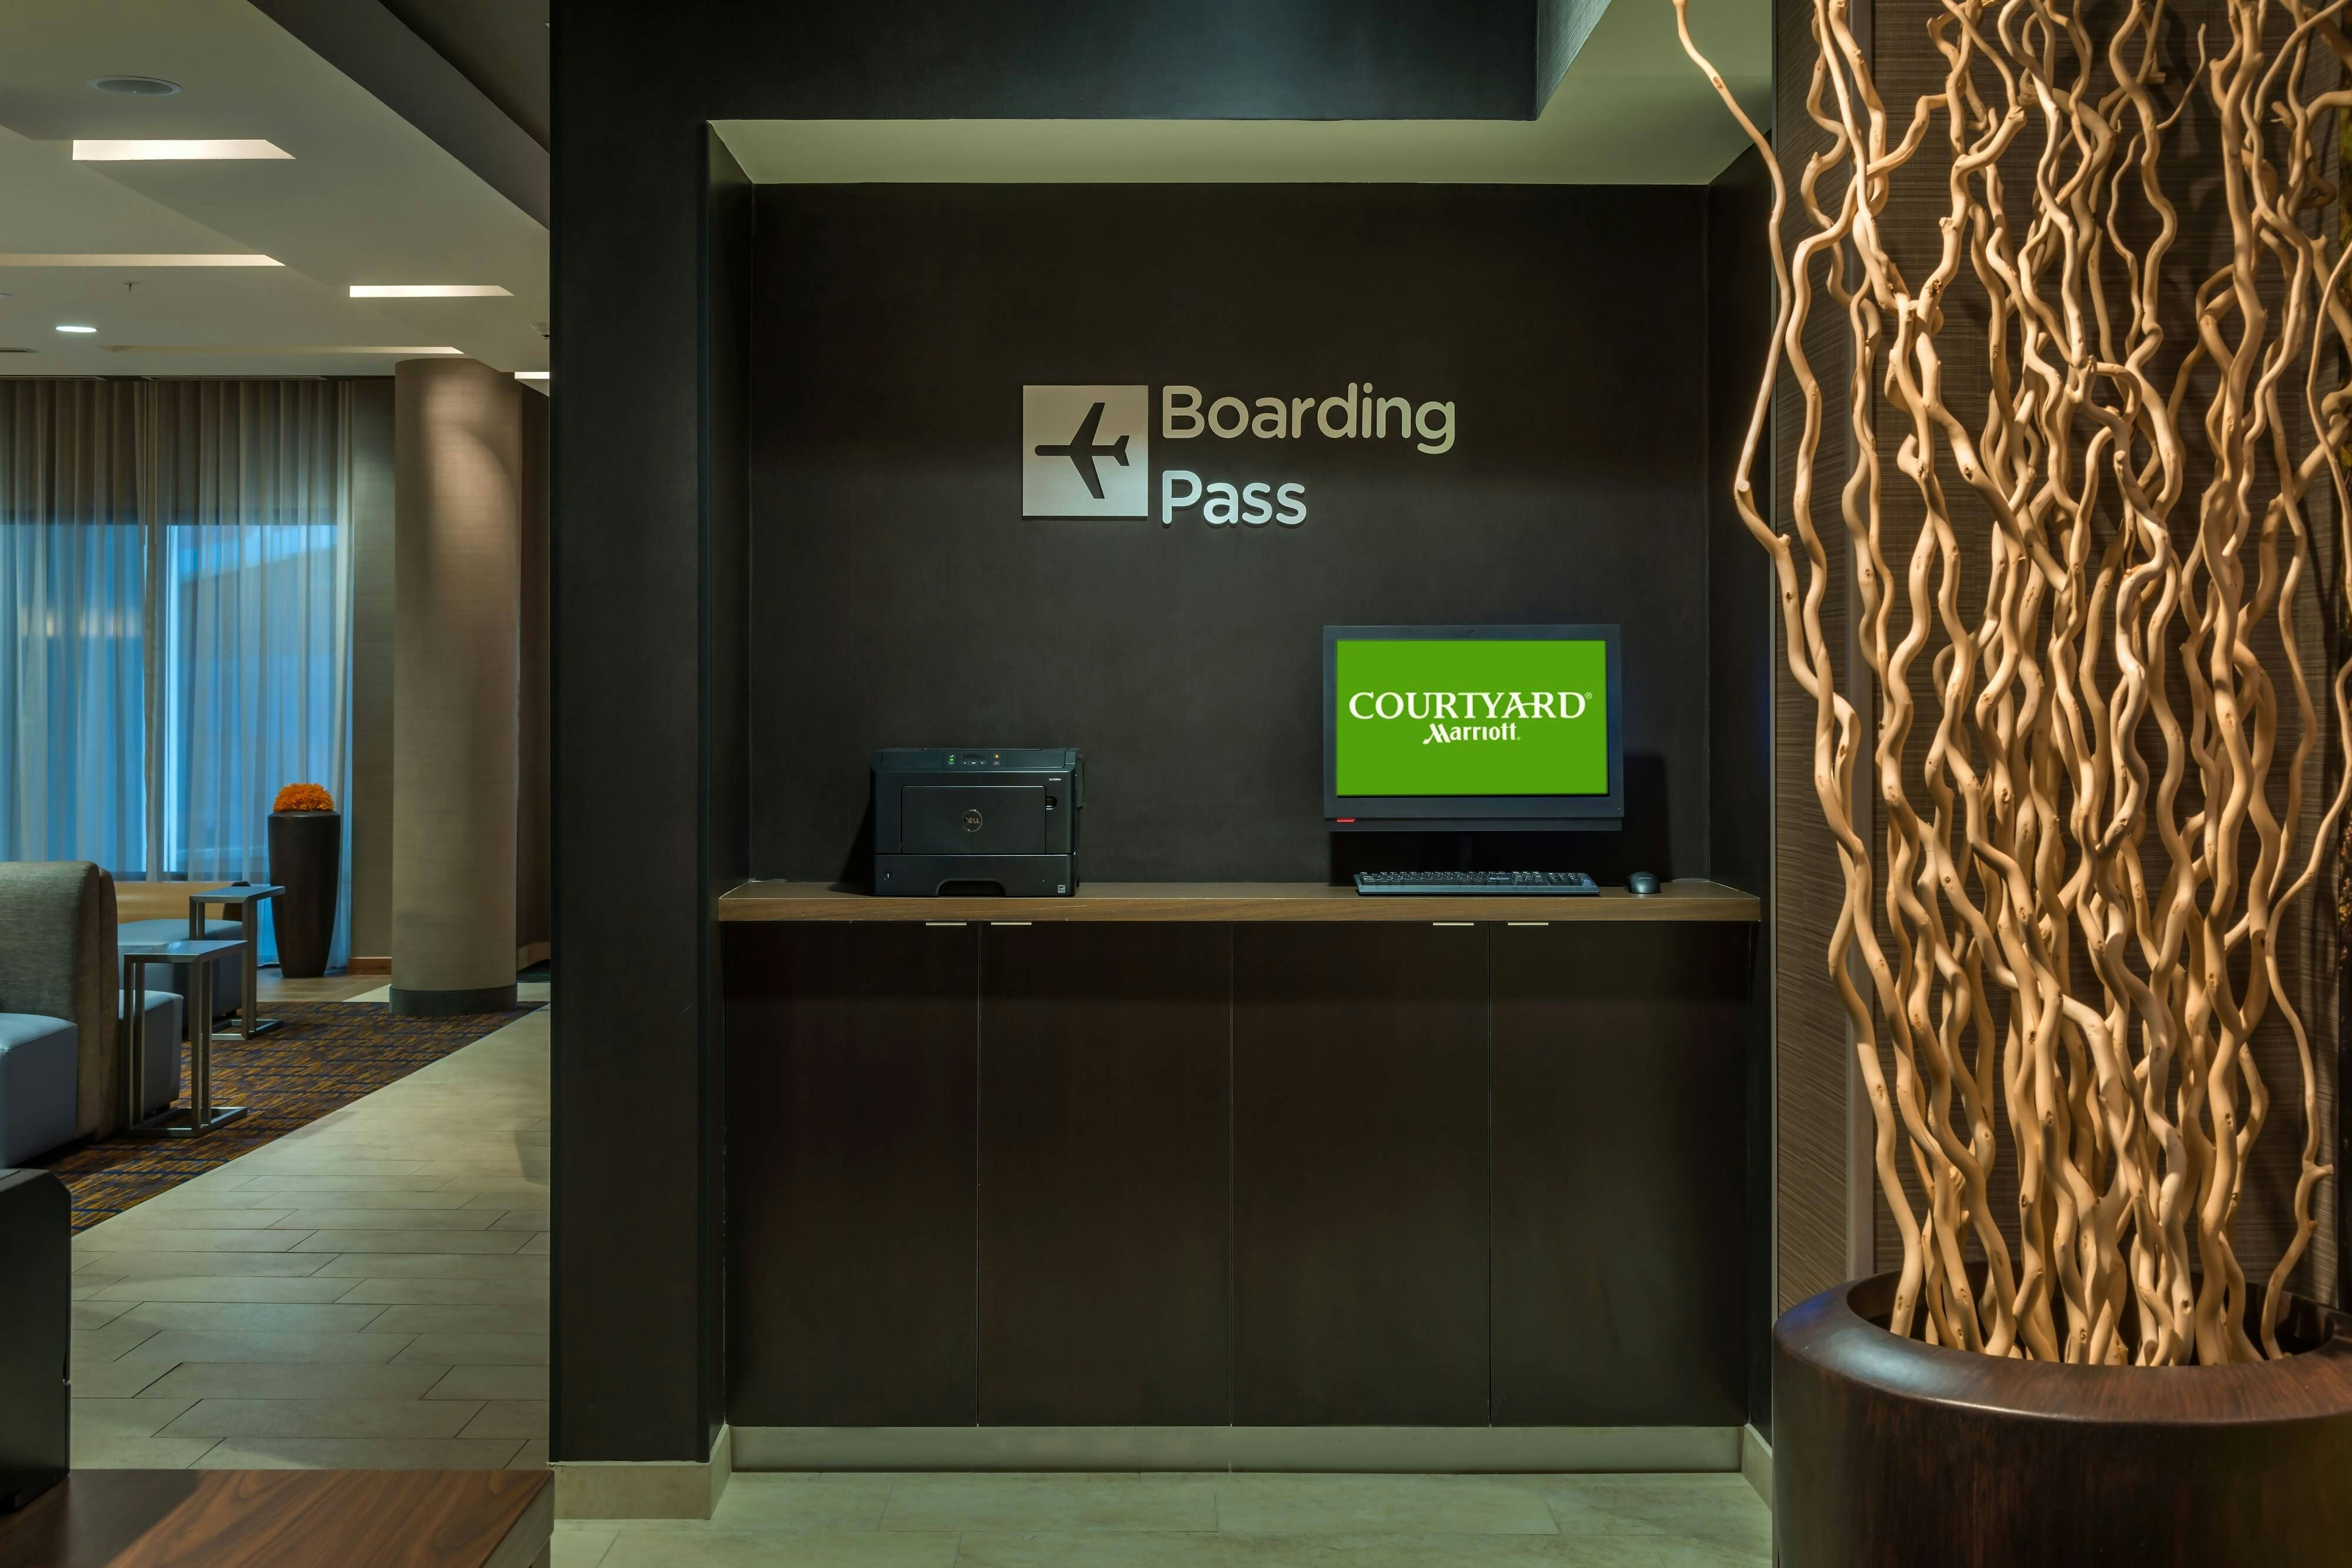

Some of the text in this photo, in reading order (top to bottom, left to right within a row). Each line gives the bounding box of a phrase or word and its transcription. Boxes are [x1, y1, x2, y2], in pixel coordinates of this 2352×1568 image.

[1162, 383, 1455, 454] Boarding
[1162, 470, 1307, 525] Pass
[1422, 722, 1517, 744] Marriott
